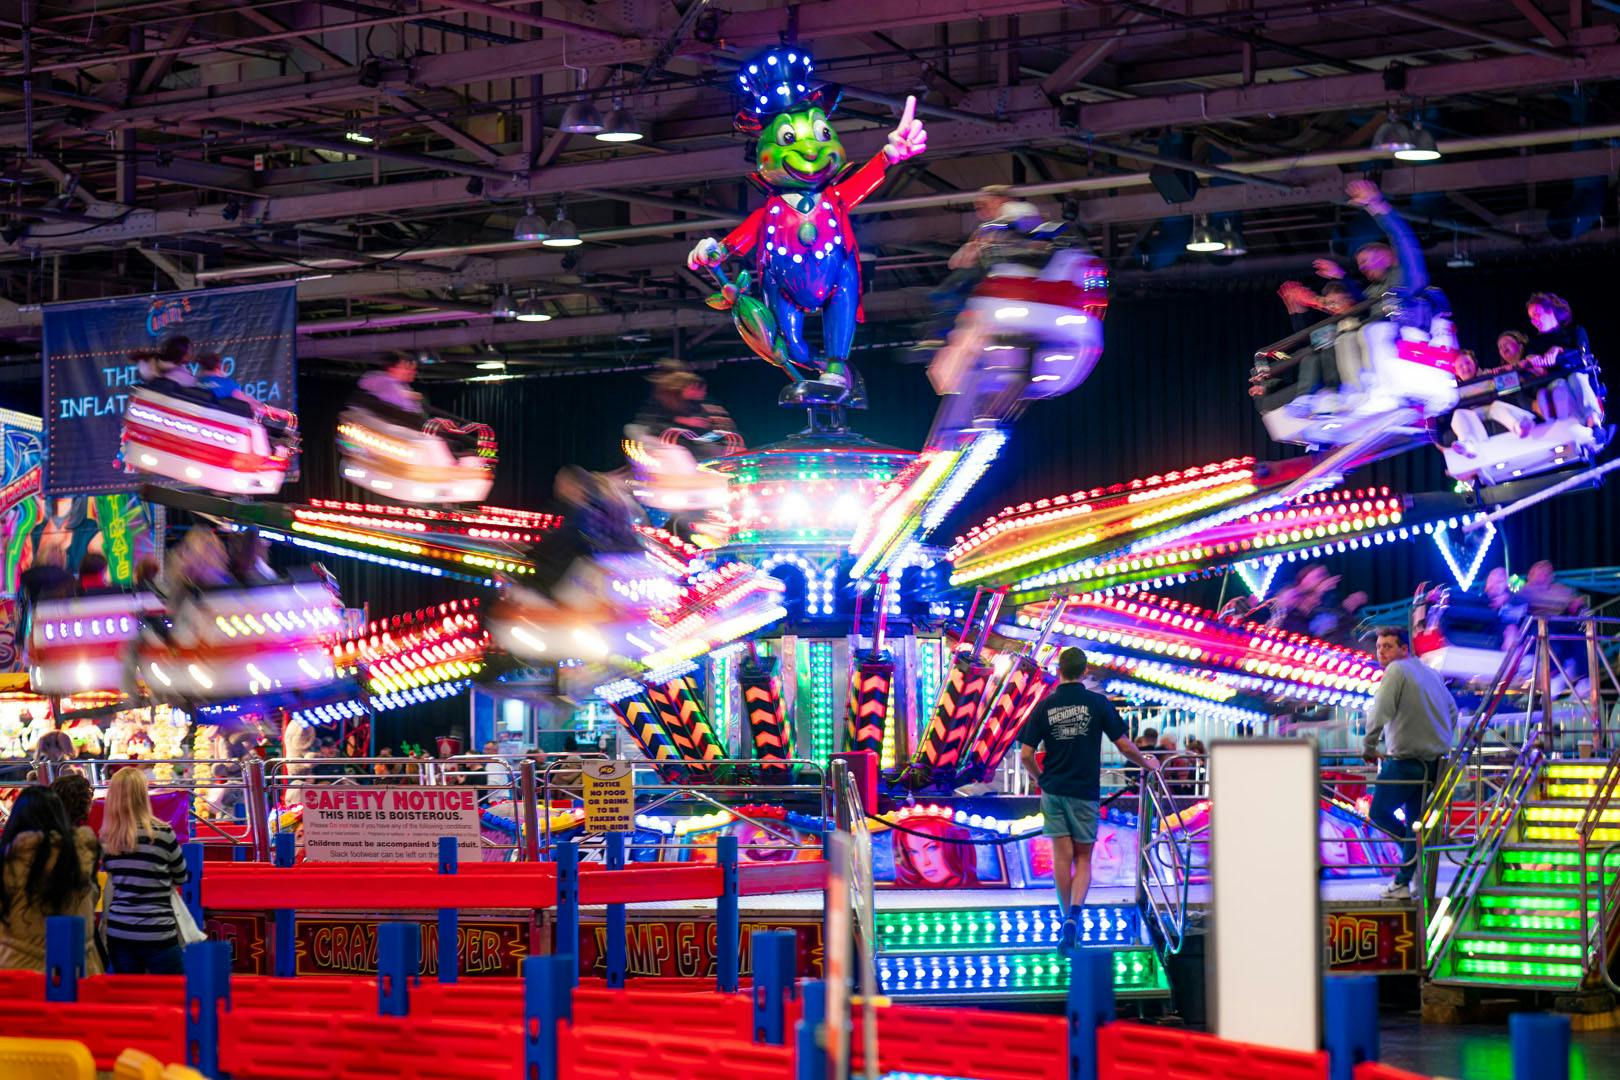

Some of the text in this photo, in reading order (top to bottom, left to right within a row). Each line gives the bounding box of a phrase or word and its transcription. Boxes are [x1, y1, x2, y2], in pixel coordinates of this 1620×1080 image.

[103, 367, 143, 388] THI
[60, 381, 282, 419] INFLAT REA
[107, 494, 130, 580] TIMATE
[305, 790, 475, 811] SAFETY NOTICE
[319, 811, 463, 821] THIS RIDE IS BOISTEROUS.
[330, 850, 348, 858] Slack
[350, 850, 379, 858] footwear
[376, 840, 430, 848] accompanied
[313, 924, 379, 974] CRAZ
[593, 922, 670, 976] JMP
[1322, 913, 1378, 965] ROG
